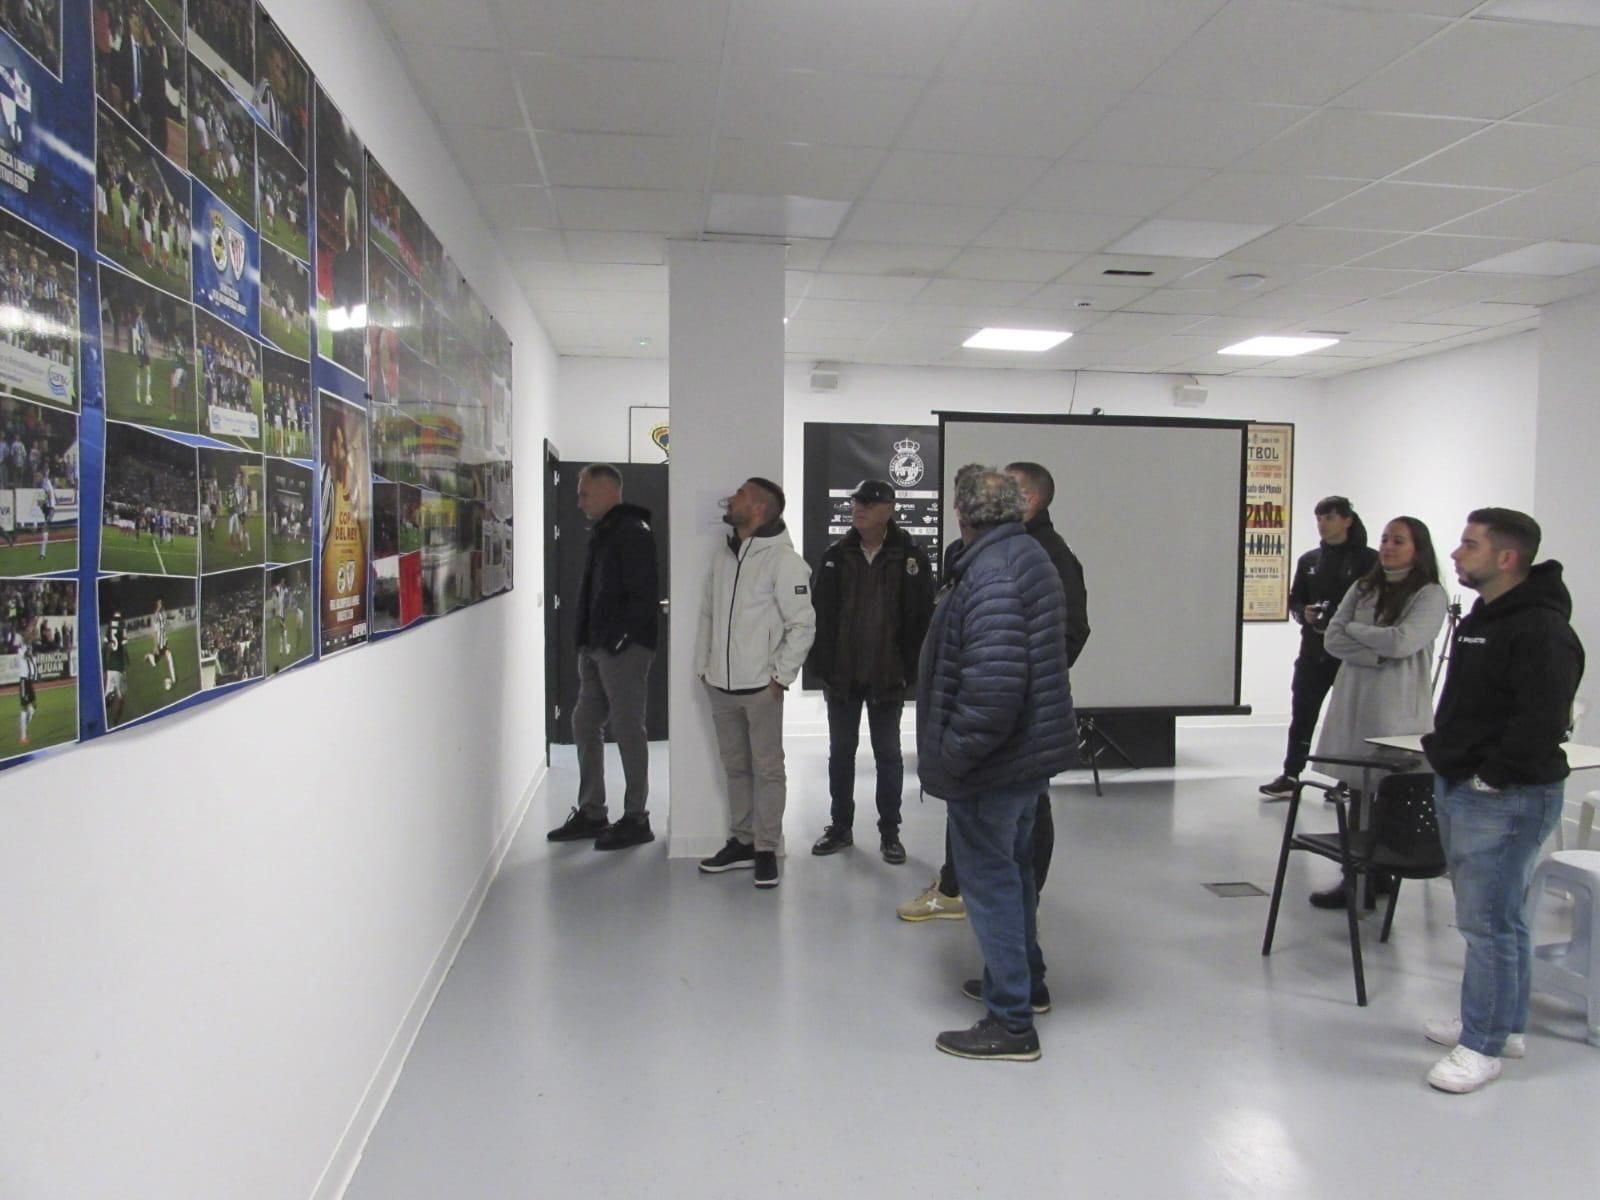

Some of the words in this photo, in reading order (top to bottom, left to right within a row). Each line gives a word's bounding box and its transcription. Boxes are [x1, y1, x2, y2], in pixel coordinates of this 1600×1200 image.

[1247, 446, 1280, 460] TBOL
[339, 512, 353, 525] COP
[1246, 501, 1283, 528] PAÑA
[1249, 534, 1282, 556] ANDIA
